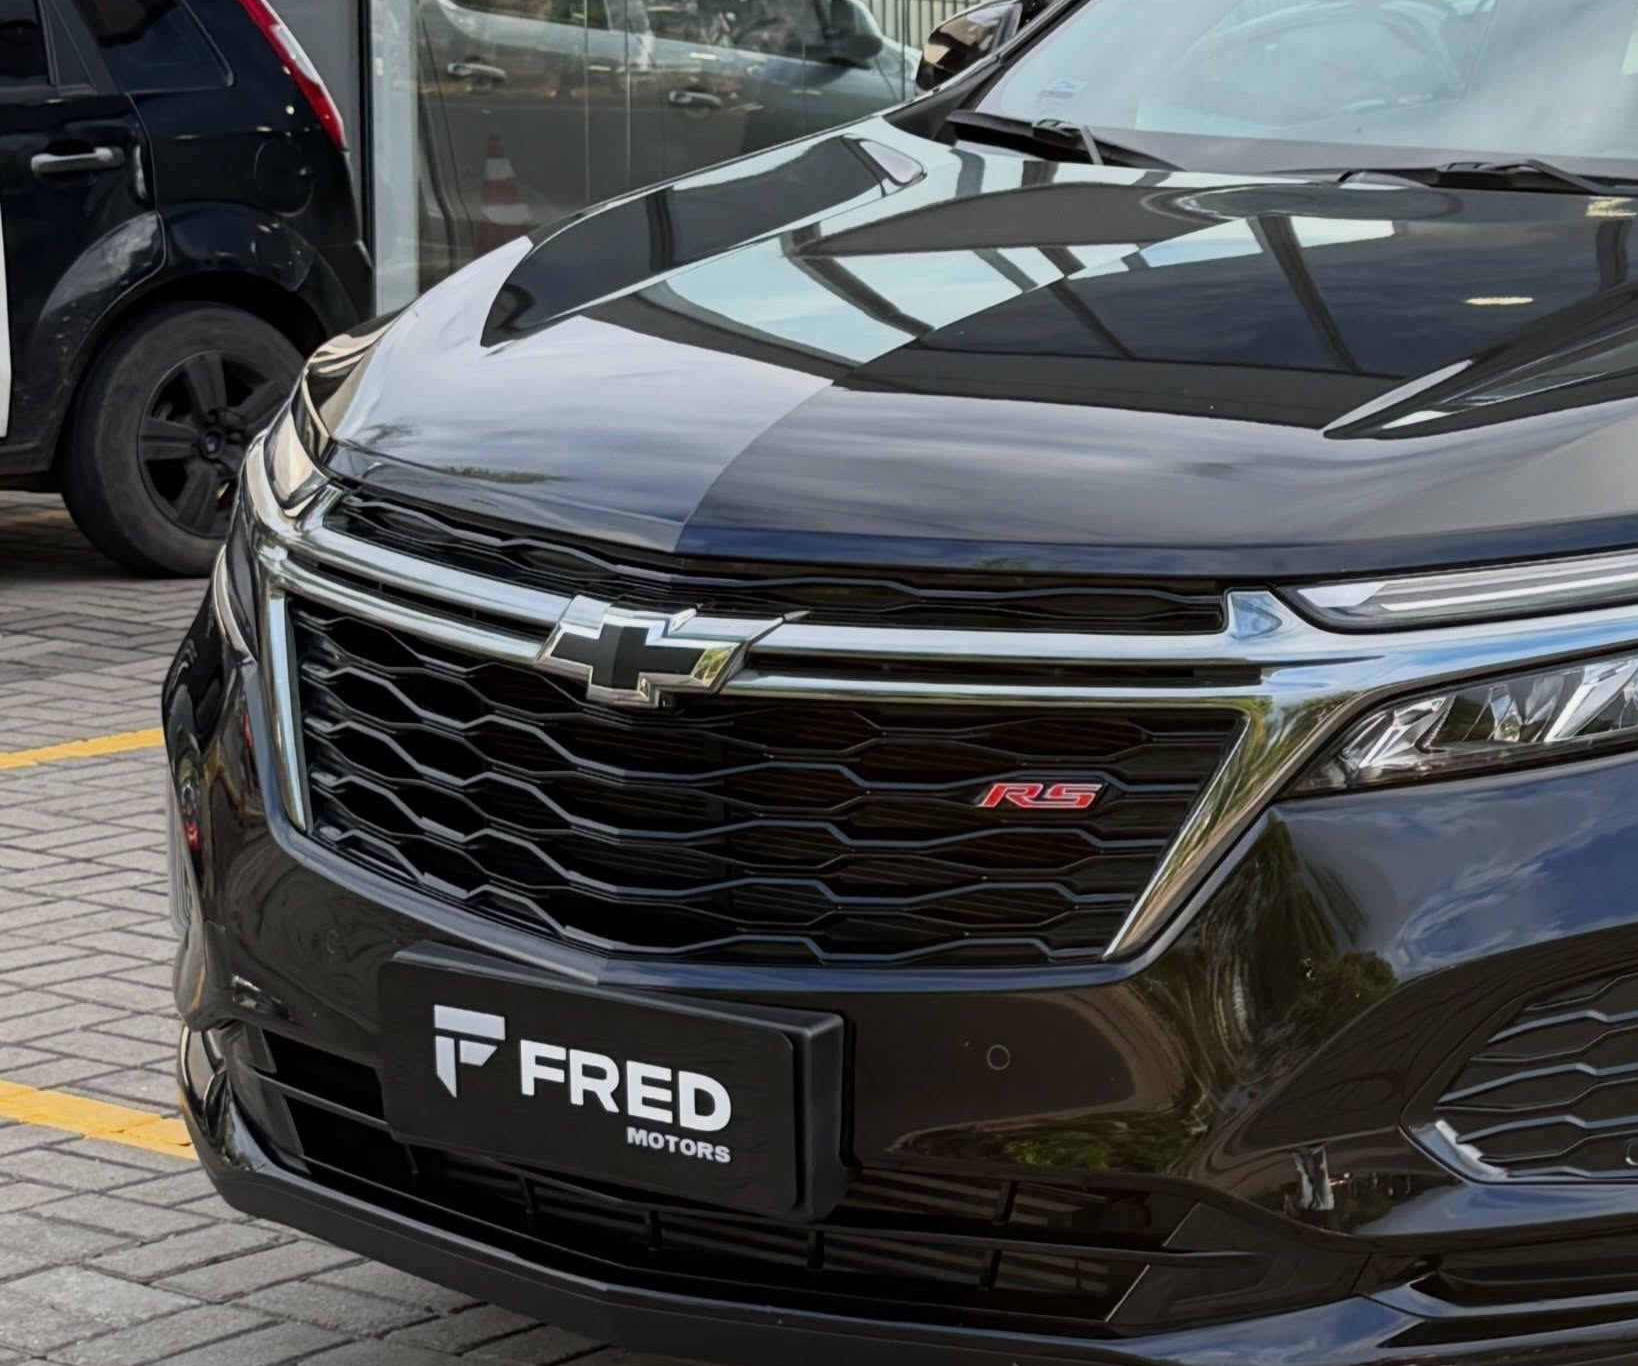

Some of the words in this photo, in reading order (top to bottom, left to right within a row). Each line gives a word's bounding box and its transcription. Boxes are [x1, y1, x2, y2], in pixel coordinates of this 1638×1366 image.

[976, 782, 1102, 809] RS
[519, 1038, 732, 1132] FRED
[626, 1126, 731, 1164] MOTORS
